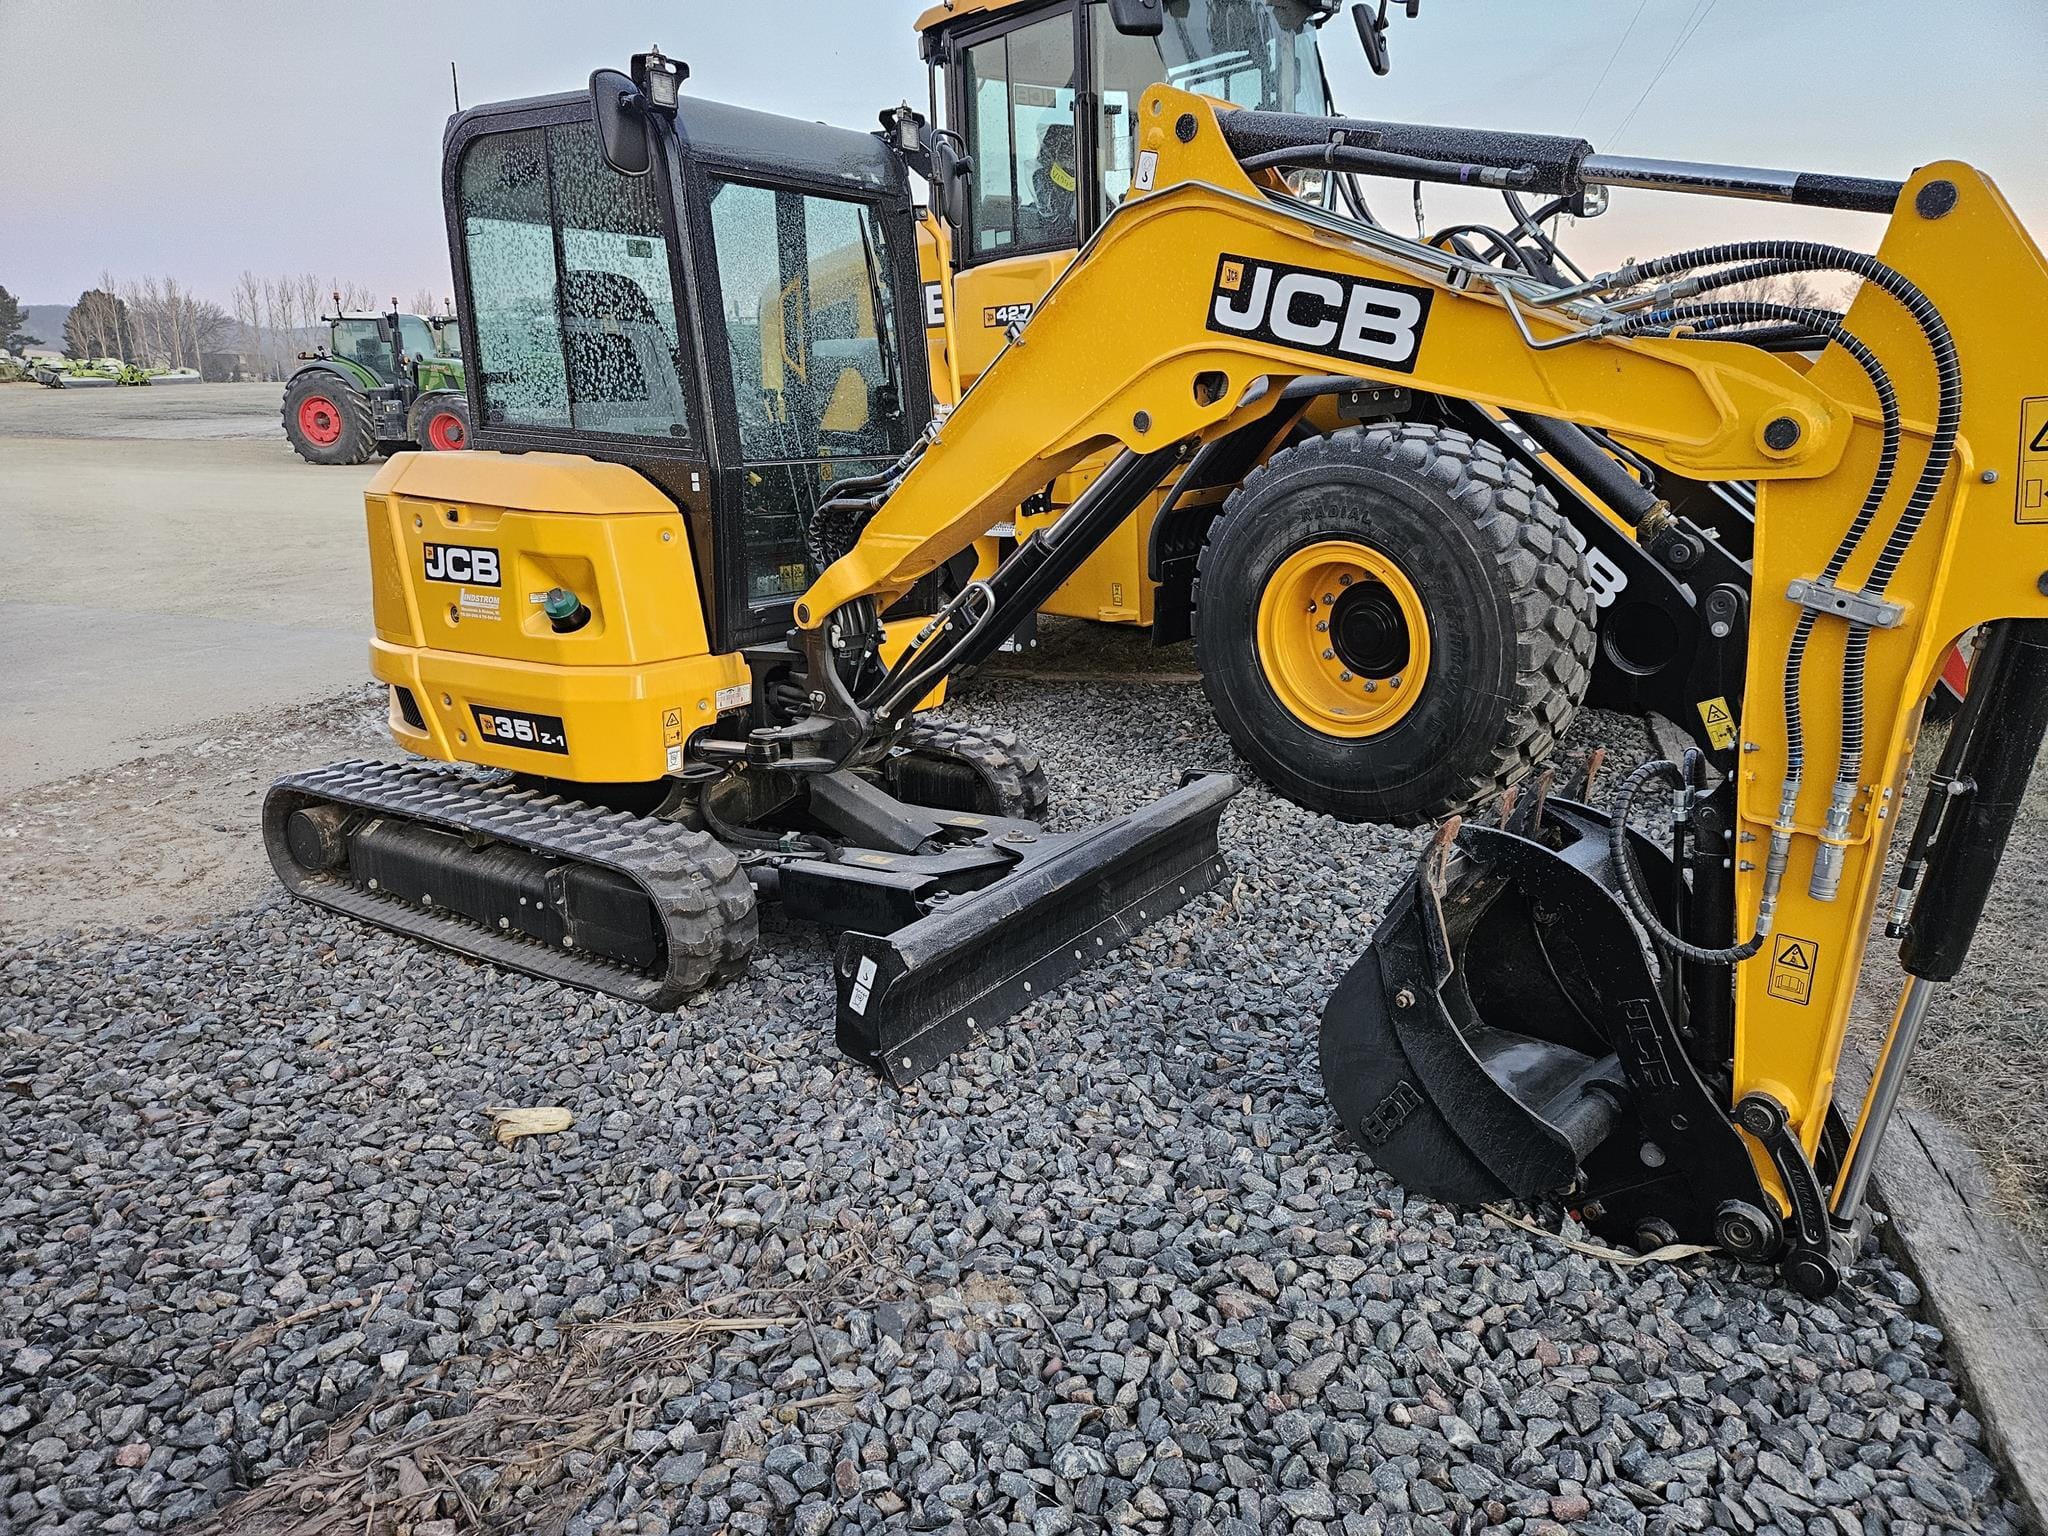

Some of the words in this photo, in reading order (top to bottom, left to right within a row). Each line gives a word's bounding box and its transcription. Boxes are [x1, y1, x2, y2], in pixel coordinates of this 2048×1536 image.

[996, 304, 1031, 322] 427
[1214, 266, 1421, 362] JCB
[1302, 504, 1373, 526] RADIAL
[426, 546, 499, 584] JCB
[460, 588, 500, 606] LINDSTROM
[495, 716, 534, 742] 35
[1360, 1080, 1424, 1146] JCB
